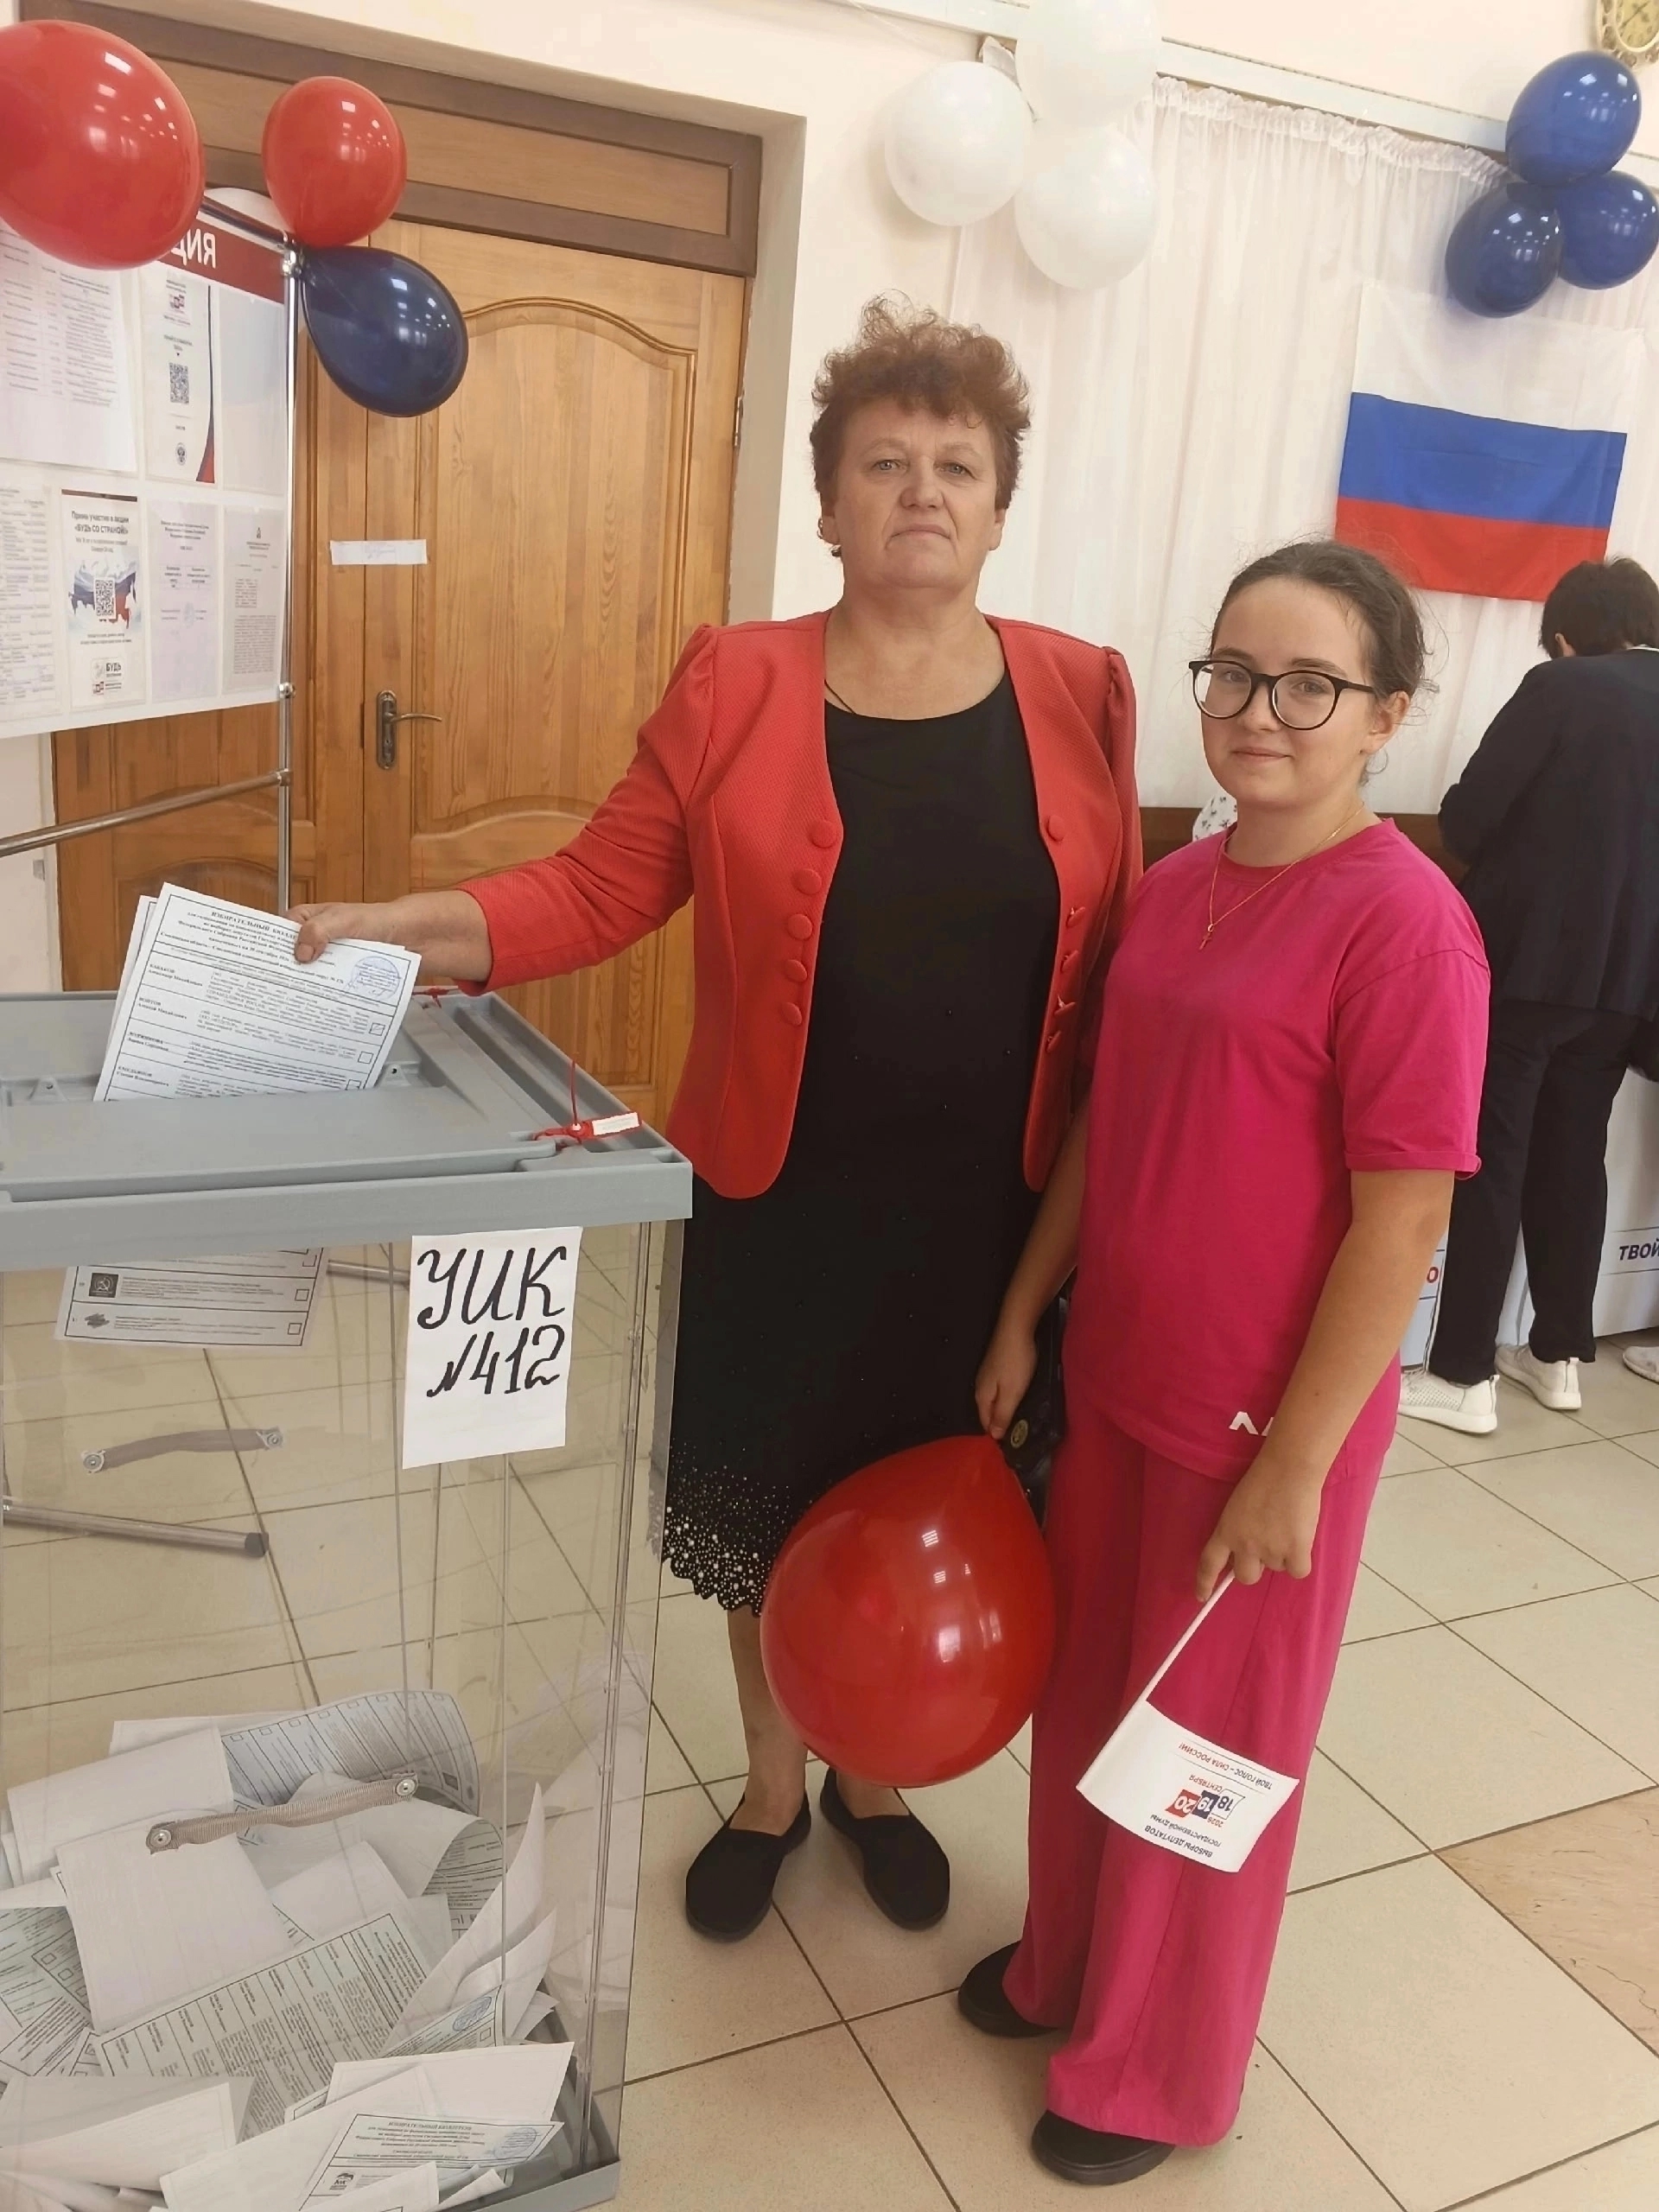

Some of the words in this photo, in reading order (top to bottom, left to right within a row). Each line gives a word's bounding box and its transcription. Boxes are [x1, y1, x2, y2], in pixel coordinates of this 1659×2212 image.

[417, 1246, 567, 1329] УИК
[1178, 1742, 1211, 1764] РОССИИ!
[1211, 1759, 1230, 1771] СИЛА
[1189, 1774, 1223, 1792] СЕНТЯБРЯ
[1234, 1768, 1256, 1783] ГОЛОС
[1255, 1780, 1273, 1790] ТВОЙ
[1173, 1796, 1197, 1814] 20
[1197, 1796, 1214, 1812] 19
[1217, 1796, 1234, 1811] 18
[1150, 1815, 1170, 1826] ДУМЫ
[1145, 1825, 1185, 1846] ДЕПУТАТОВ
[1168, 1822, 1222, 1847] ГОСУДАРСТВЕННОЙ
[1184, 1841, 1213, 1858] ВЫБОРЫ
